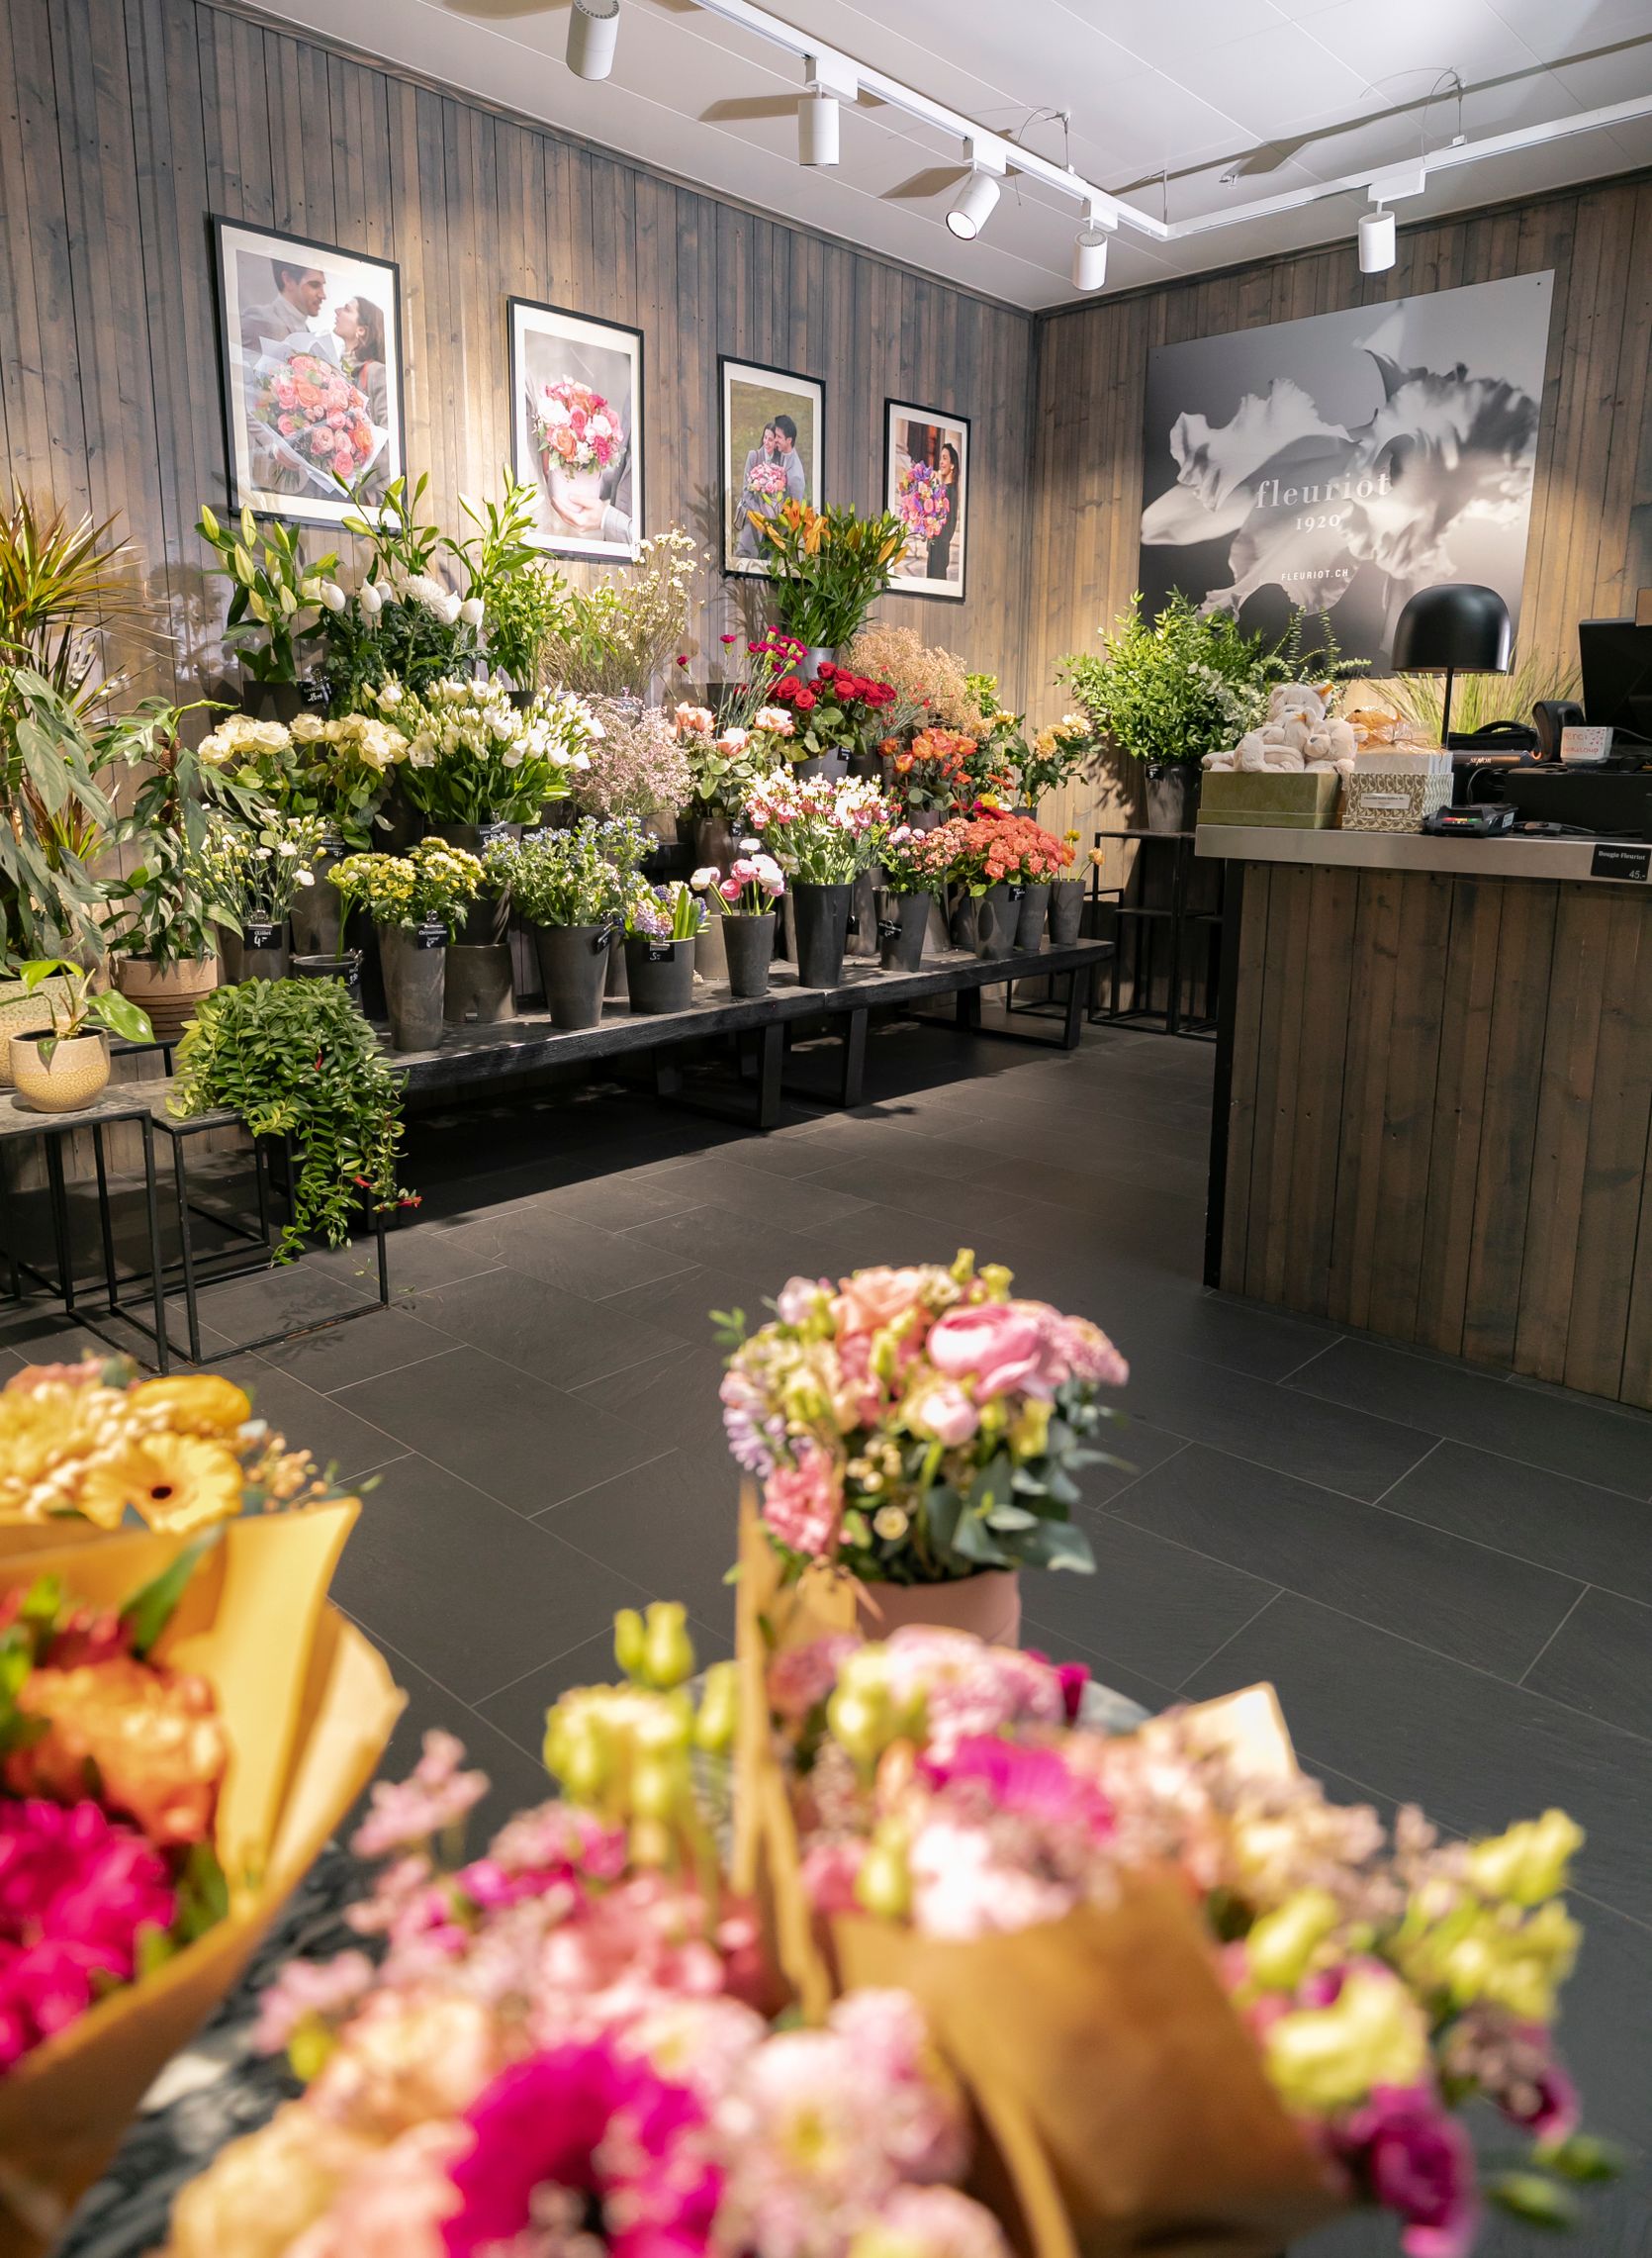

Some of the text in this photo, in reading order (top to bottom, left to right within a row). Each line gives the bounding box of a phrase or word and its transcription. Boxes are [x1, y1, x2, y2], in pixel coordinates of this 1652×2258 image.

[1255, 473, 1390, 509] fleuriot
[1296, 514, 1341, 533] 1920
[1281, 568, 1349, 582] FLEURIOT.CH
[1598, 850, 1646, 861] Bougie Fleuriot
[1628, 870, 1646, 880] 45.-
